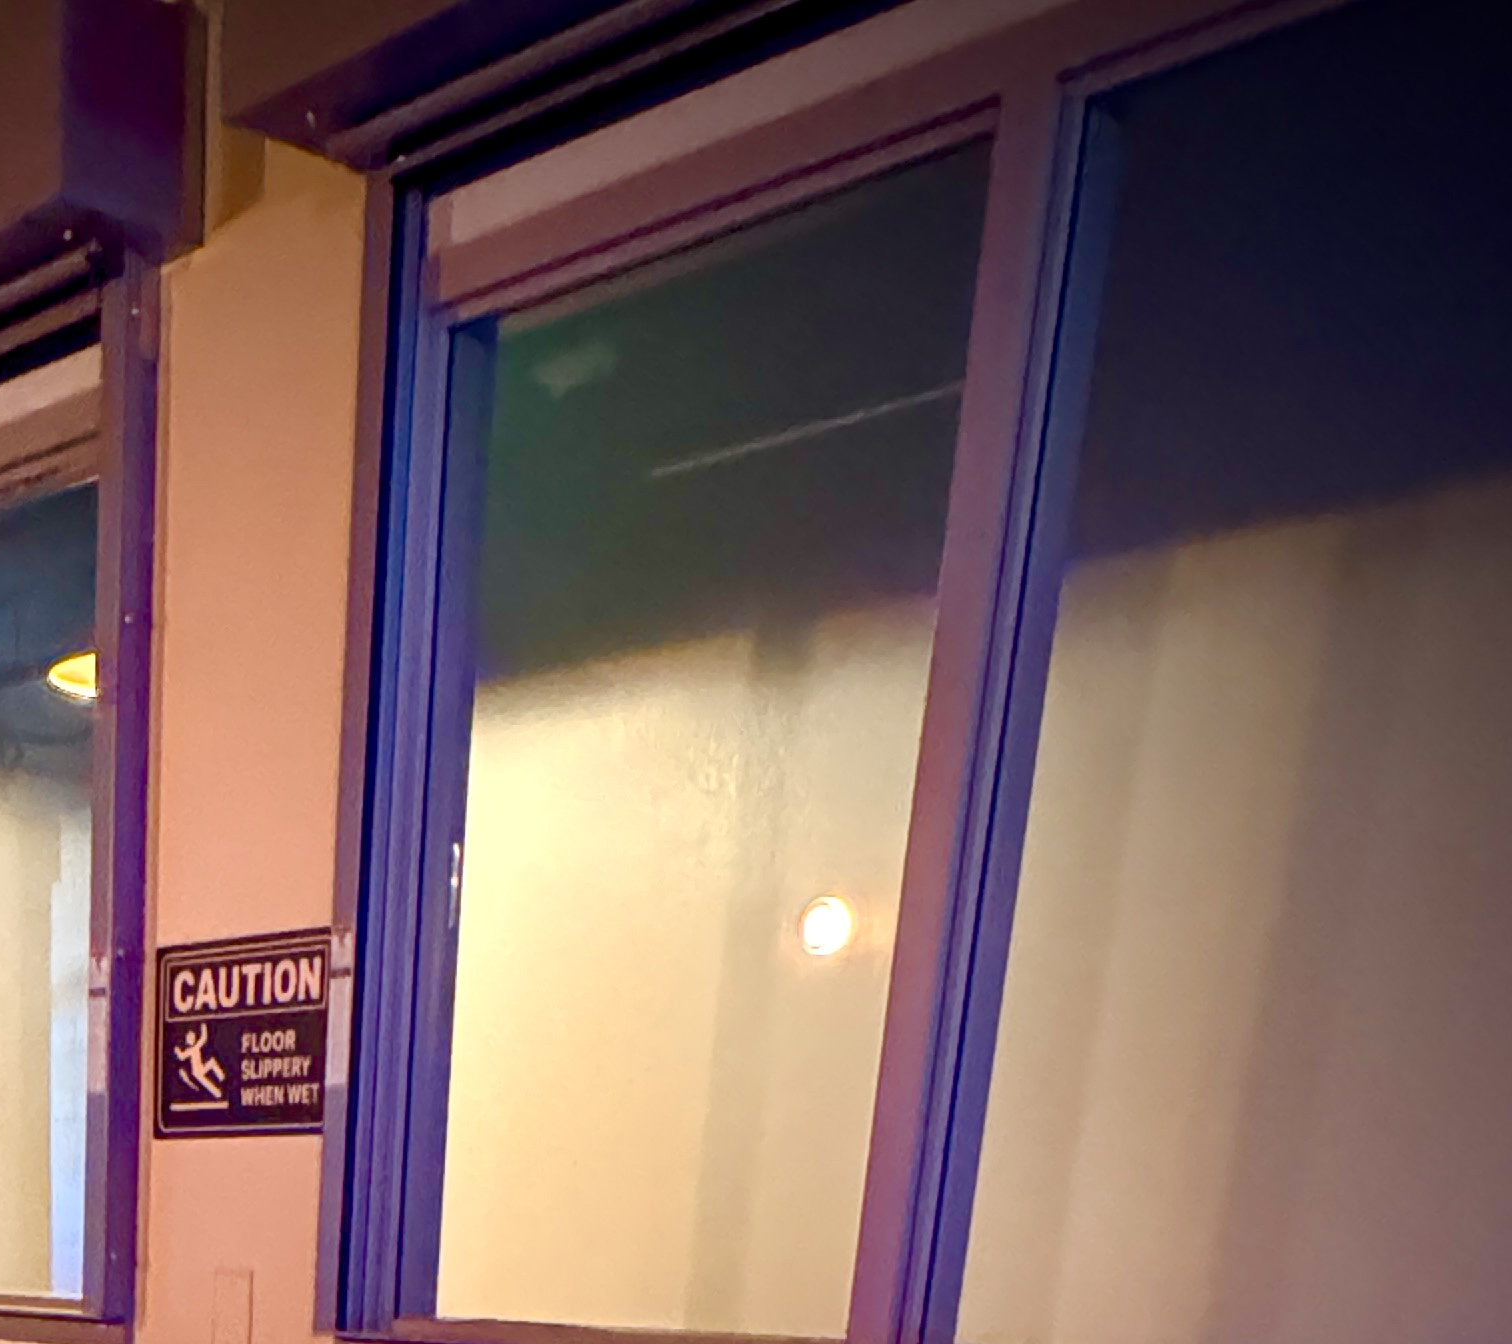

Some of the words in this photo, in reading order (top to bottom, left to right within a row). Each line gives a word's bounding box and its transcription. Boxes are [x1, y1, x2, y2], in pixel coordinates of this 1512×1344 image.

[172, 955, 322, 1013] CAUTION
[241, 1029, 296, 1053] FLOOR
[241, 1056, 312, 1081] SLIPPERY
[241, 1084, 286, 1106] WHEN
[287, 1082, 320, 1105] WET
